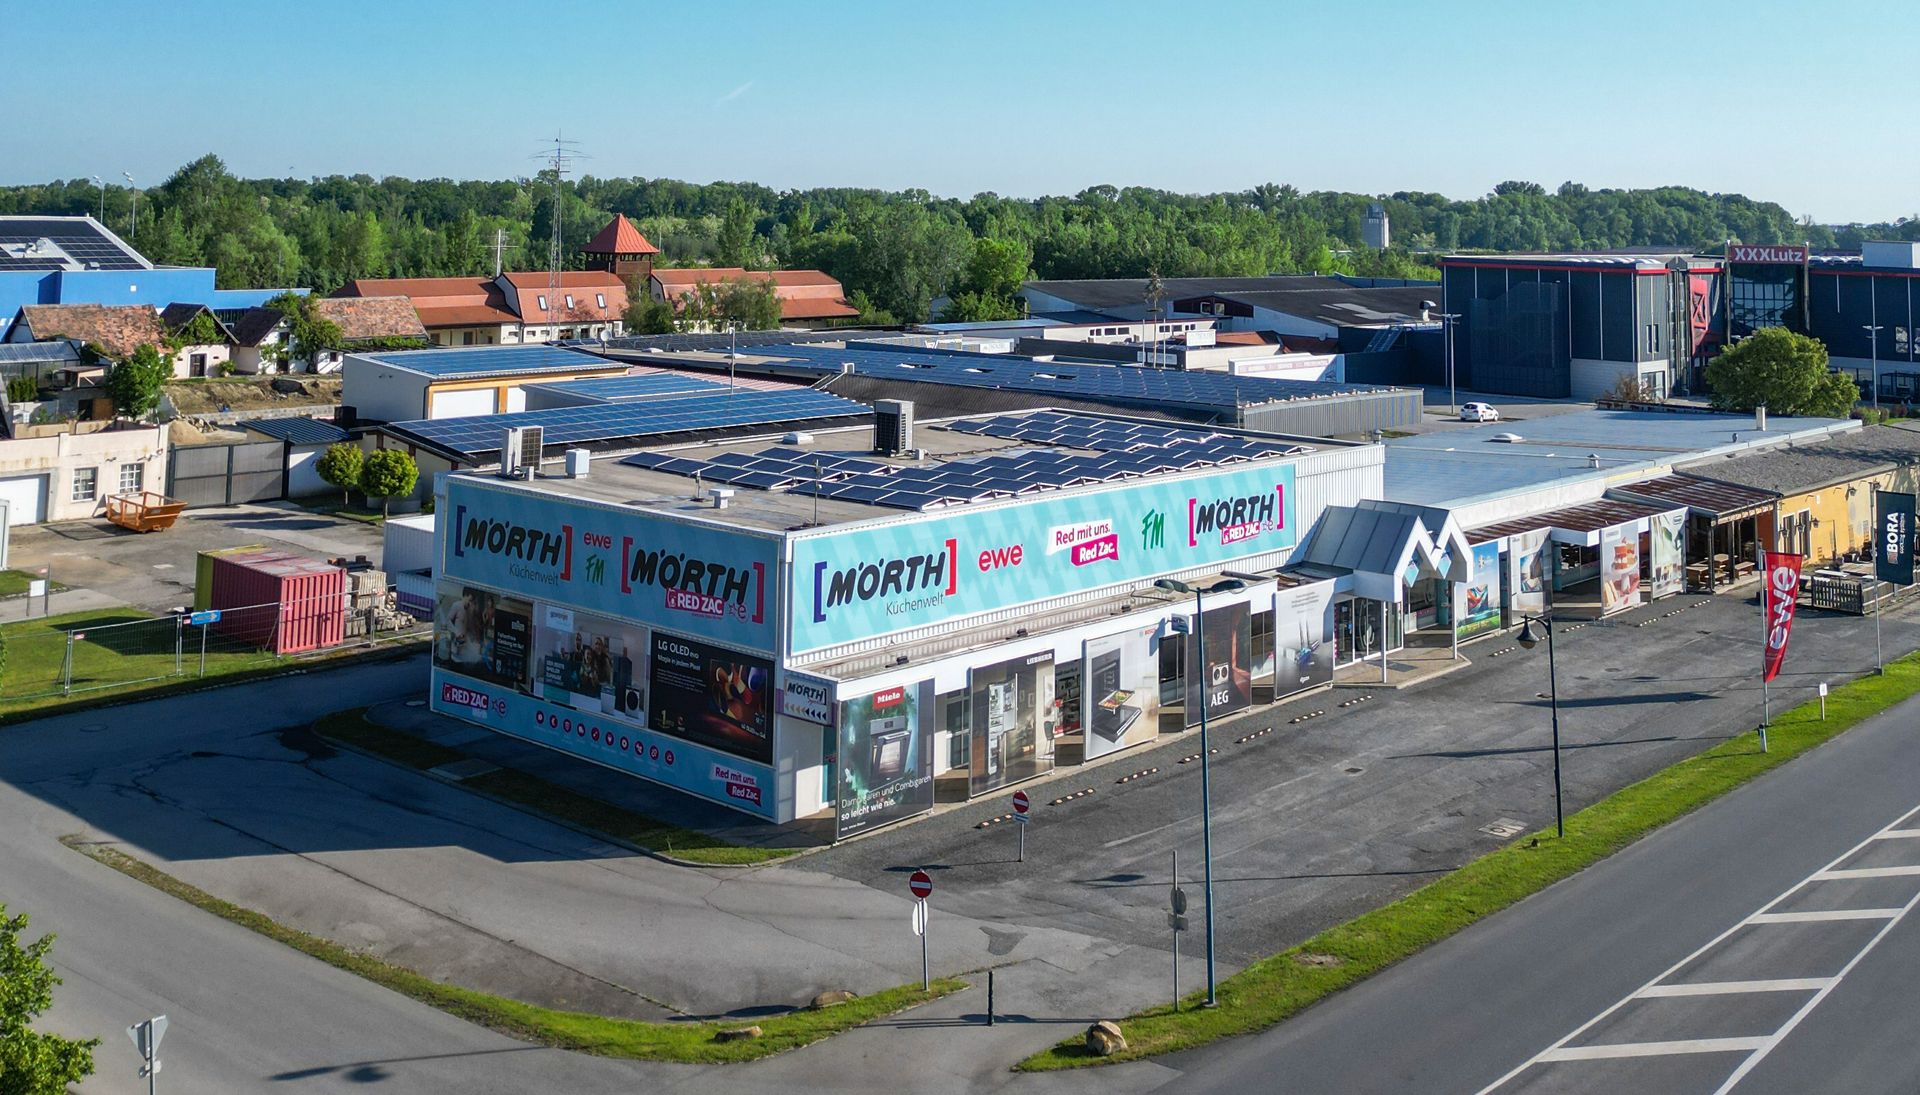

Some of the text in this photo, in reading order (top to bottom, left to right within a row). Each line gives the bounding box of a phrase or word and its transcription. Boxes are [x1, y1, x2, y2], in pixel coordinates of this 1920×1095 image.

[1734, 247, 1804, 262] XXXLutz
[1056, 523, 1111, 546] Red mit uns.
[1141, 507, 1166, 551] FM
[1229, 526, 1245, 540] RED
[1245, 523, 1260, 537] ZAC
[1886, 512, 1899, 553] BORA
[583, 531, 612, 549] ewe
[978, 544, 1023, 572] ewe
[1079, 541, 1115, 563] Red Zac.
[509, 562, 560, 587] Küchenwelt
[585, 554, 605, 586] FM
[677, 592, 700, 611] RED
[701, 596, 723, 615] ZAC
[885, 592, 944, 617] Küchenwelt
[1769, 566, 1796, 650] ewe
[658, 640, 667, 650] LG
[669, 643, 689, 656] OLED
[451, 688, 470, 704] RED
[470, 692, 488, 709] ZAC
[877, 692, 901, 704] Miele
[1210, 690, 1229, 707] AEG
[715, 766, 729, 779] Red
[730, 771, 742, 782] mit
[732, 785, 745, 797] Red
[881, 785, 894, 796] und
[841, 812, 850, 821] so
[850, 806, 870, 818] leicht
[870, 802, 883, 812] wie
